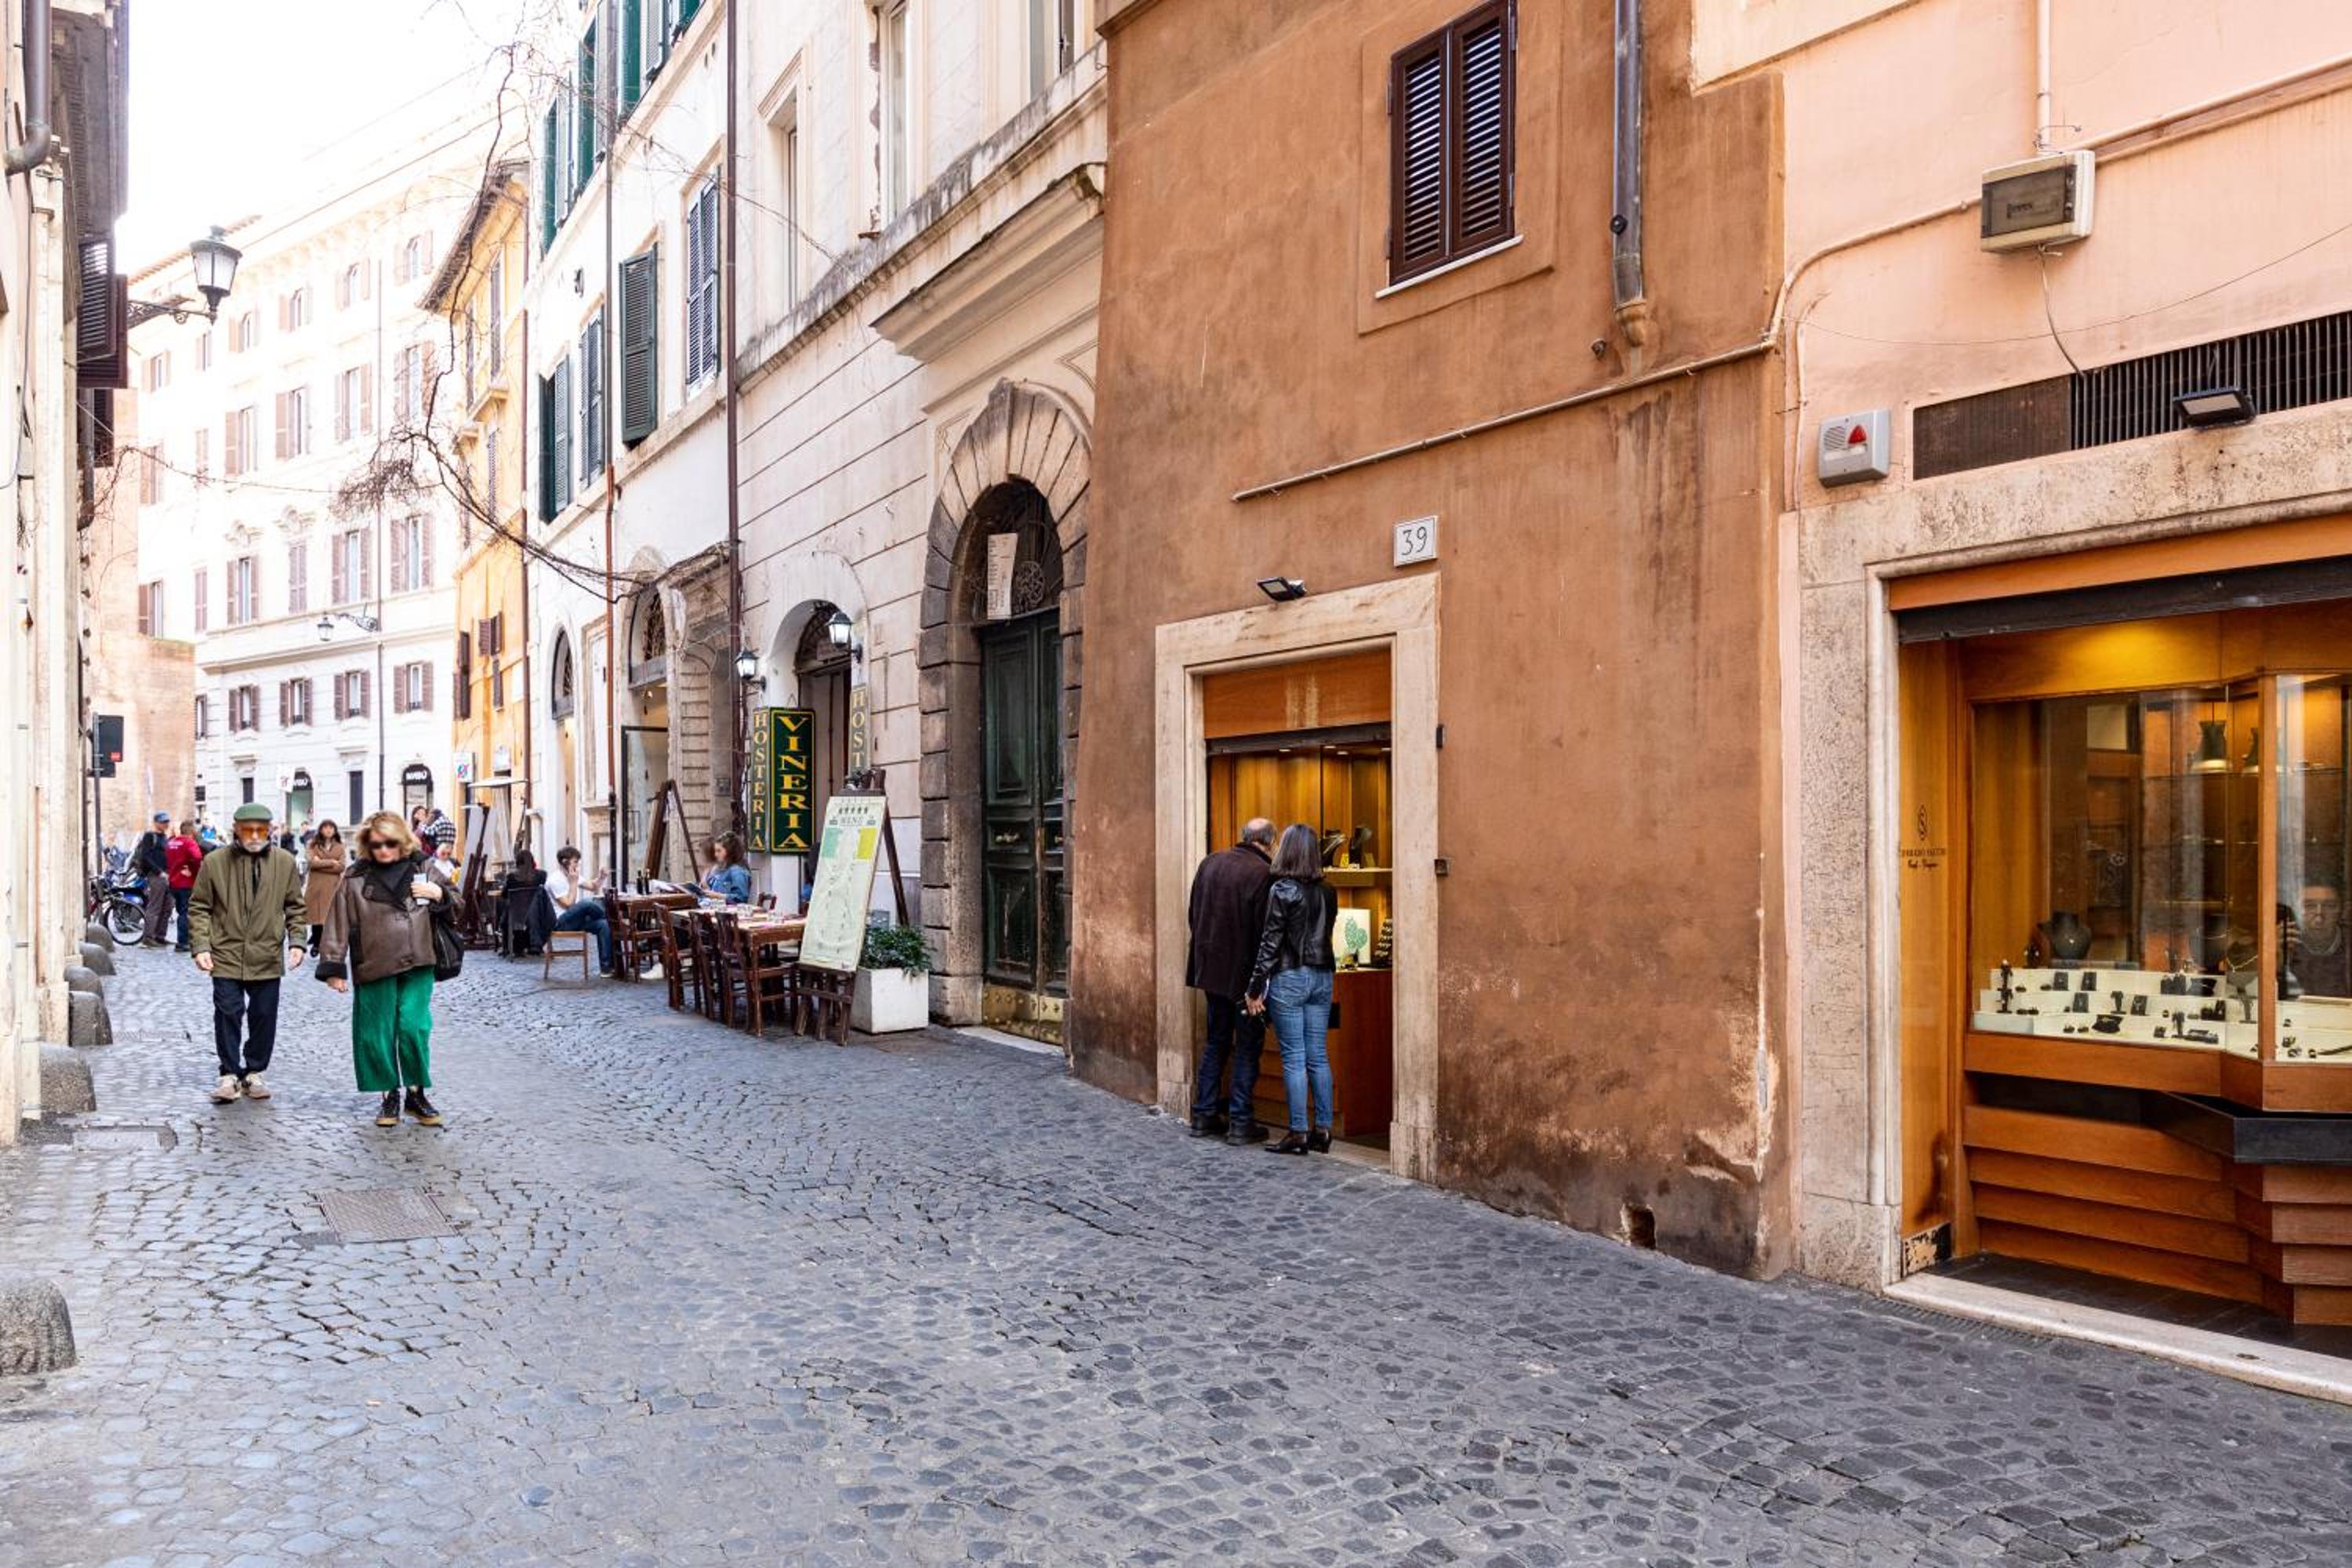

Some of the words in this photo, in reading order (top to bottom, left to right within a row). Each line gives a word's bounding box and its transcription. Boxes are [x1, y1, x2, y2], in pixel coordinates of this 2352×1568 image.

[1401, 526, 1428, 556] 39
[752, 713, 768, 848] HOSTERIA
[778, 716, 809, 848] VINERIA
